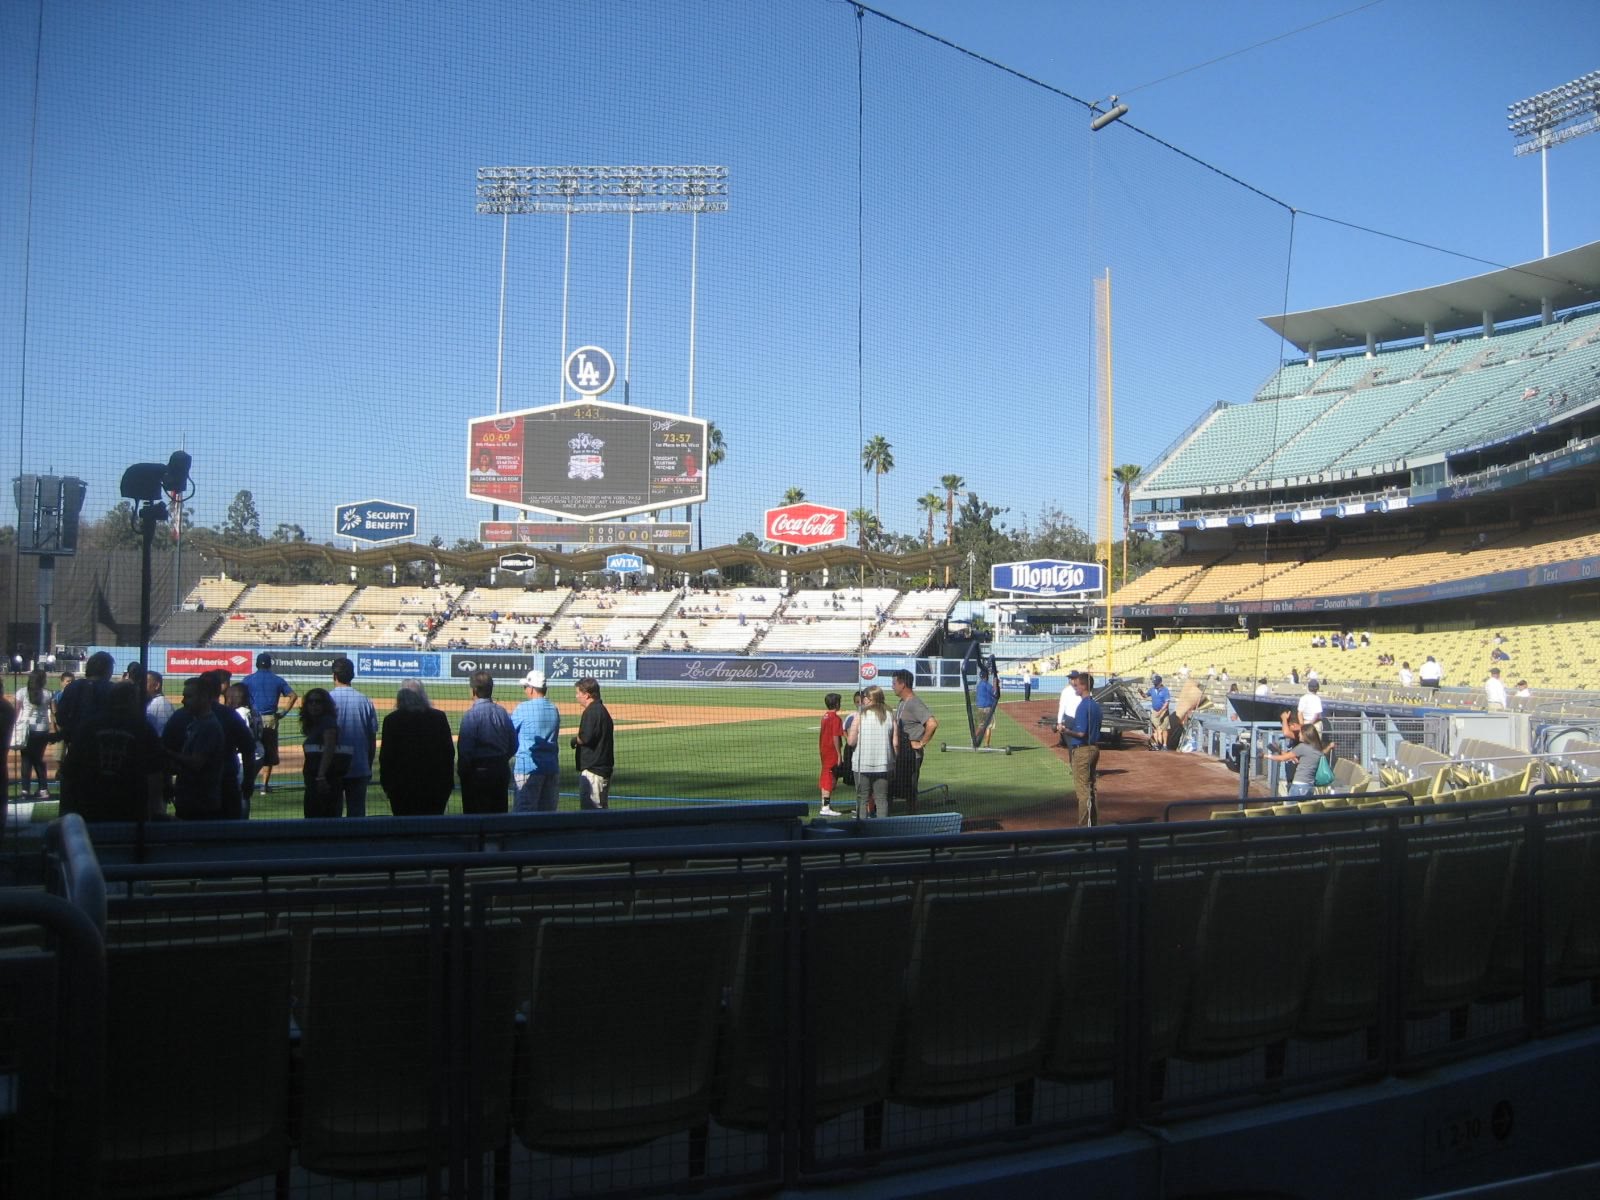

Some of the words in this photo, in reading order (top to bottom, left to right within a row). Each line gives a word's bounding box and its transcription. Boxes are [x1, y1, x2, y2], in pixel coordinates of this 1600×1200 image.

[577, 354, 600, 386] LA
[574, 408, 600, 419] 4:43
[483, 433, 511, 442] 60-69
[664, 433, 691, 443] 73-57
[1201, 480, 1272, 496] DODGER
[1284, 469, 1359, 488] STADIUM
[1371, 458, 1408, 476] CLUB
[366, 511, 411, 520] SECURITY
[771, 513, 839, 536] Coca-Cola
[652, 529, 689, 538] SUBWAY
[1543, 568, 1558, 582] Text
[1582, 564, 1591, 577] to
[1010, 565, 1084, 590] Montejo
[1224, 605, 1234, 613] Be
[1273, 602, 1281, 611] in
[1282, 601, 1293, 611] the
[1324, 599, 1346, 609] Donate
[1130, 607, 1150, 616] Text
[1178, 606, 1188, 614] to
[171, 657, 189, 666] Bank
[190, 657, 198, 666] of
[198, 657, 229, 666] America
[275, 659, 293, 667] Time
[294, 659, 322, 668] Warner
[373, 659, 397, 667] Merrill
[398, 659, 419, 669] Lynch
[573, 657, 622, 667] SECURITY
[680, 661, 705, 680] Los
[705, 661, 758, 682] Angeles
[758, 661, 815, 683] Dodgers
[862, 667, 874, 675] 76
